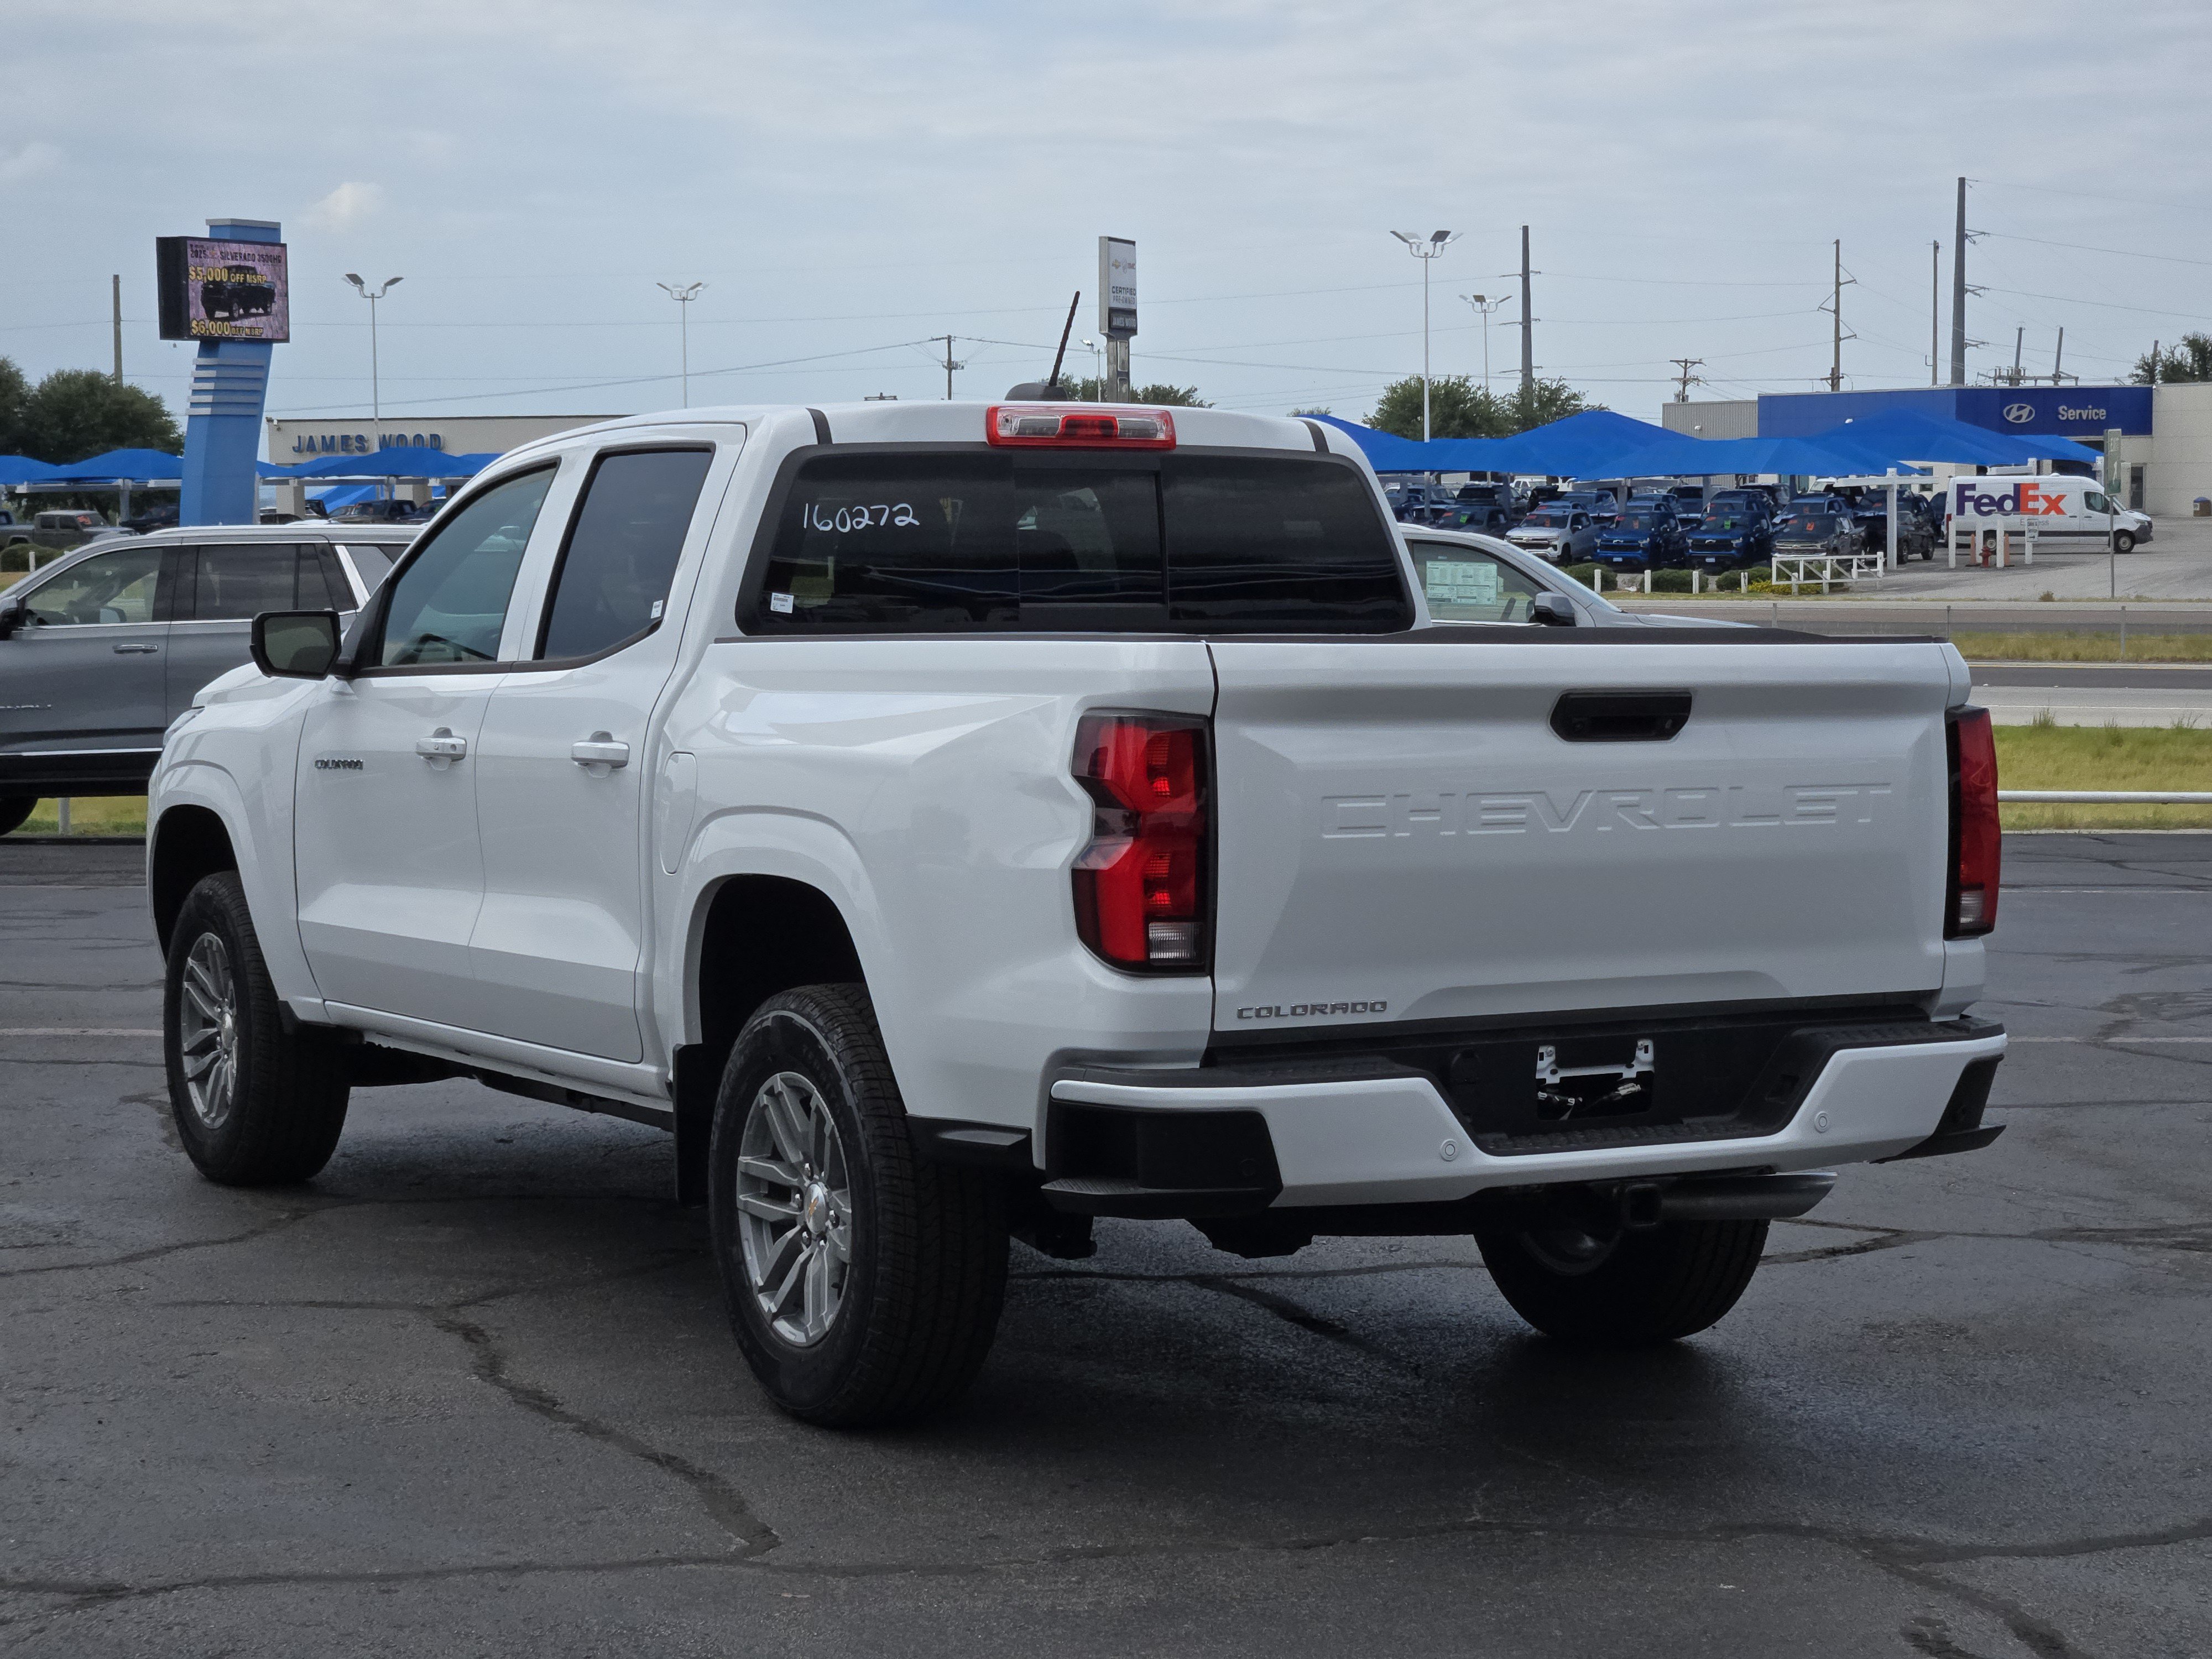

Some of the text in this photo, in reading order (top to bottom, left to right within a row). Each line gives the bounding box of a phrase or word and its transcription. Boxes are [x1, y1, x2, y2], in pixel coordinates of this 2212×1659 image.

[190, 249, 208, 259] 2025
[220, 251, 256, 263] SILVERADO
[189, 265, 267, 284] $5,000 OFF MSRP
[1112, 286, 1136, 296] CERTIFIED
[191, 319, 230, 336] $6,000
[2058, 405, 2106, 420] Service
[292, 434, 442, 453] JAMES WOOD
[1956, 483, 2068, 517] FedEx
[804, 503, 920, 533] 160272
[1321, 782, 1892, 838] CHEVROLET
[1237, 1000, 1387, 1019] COLORADO
